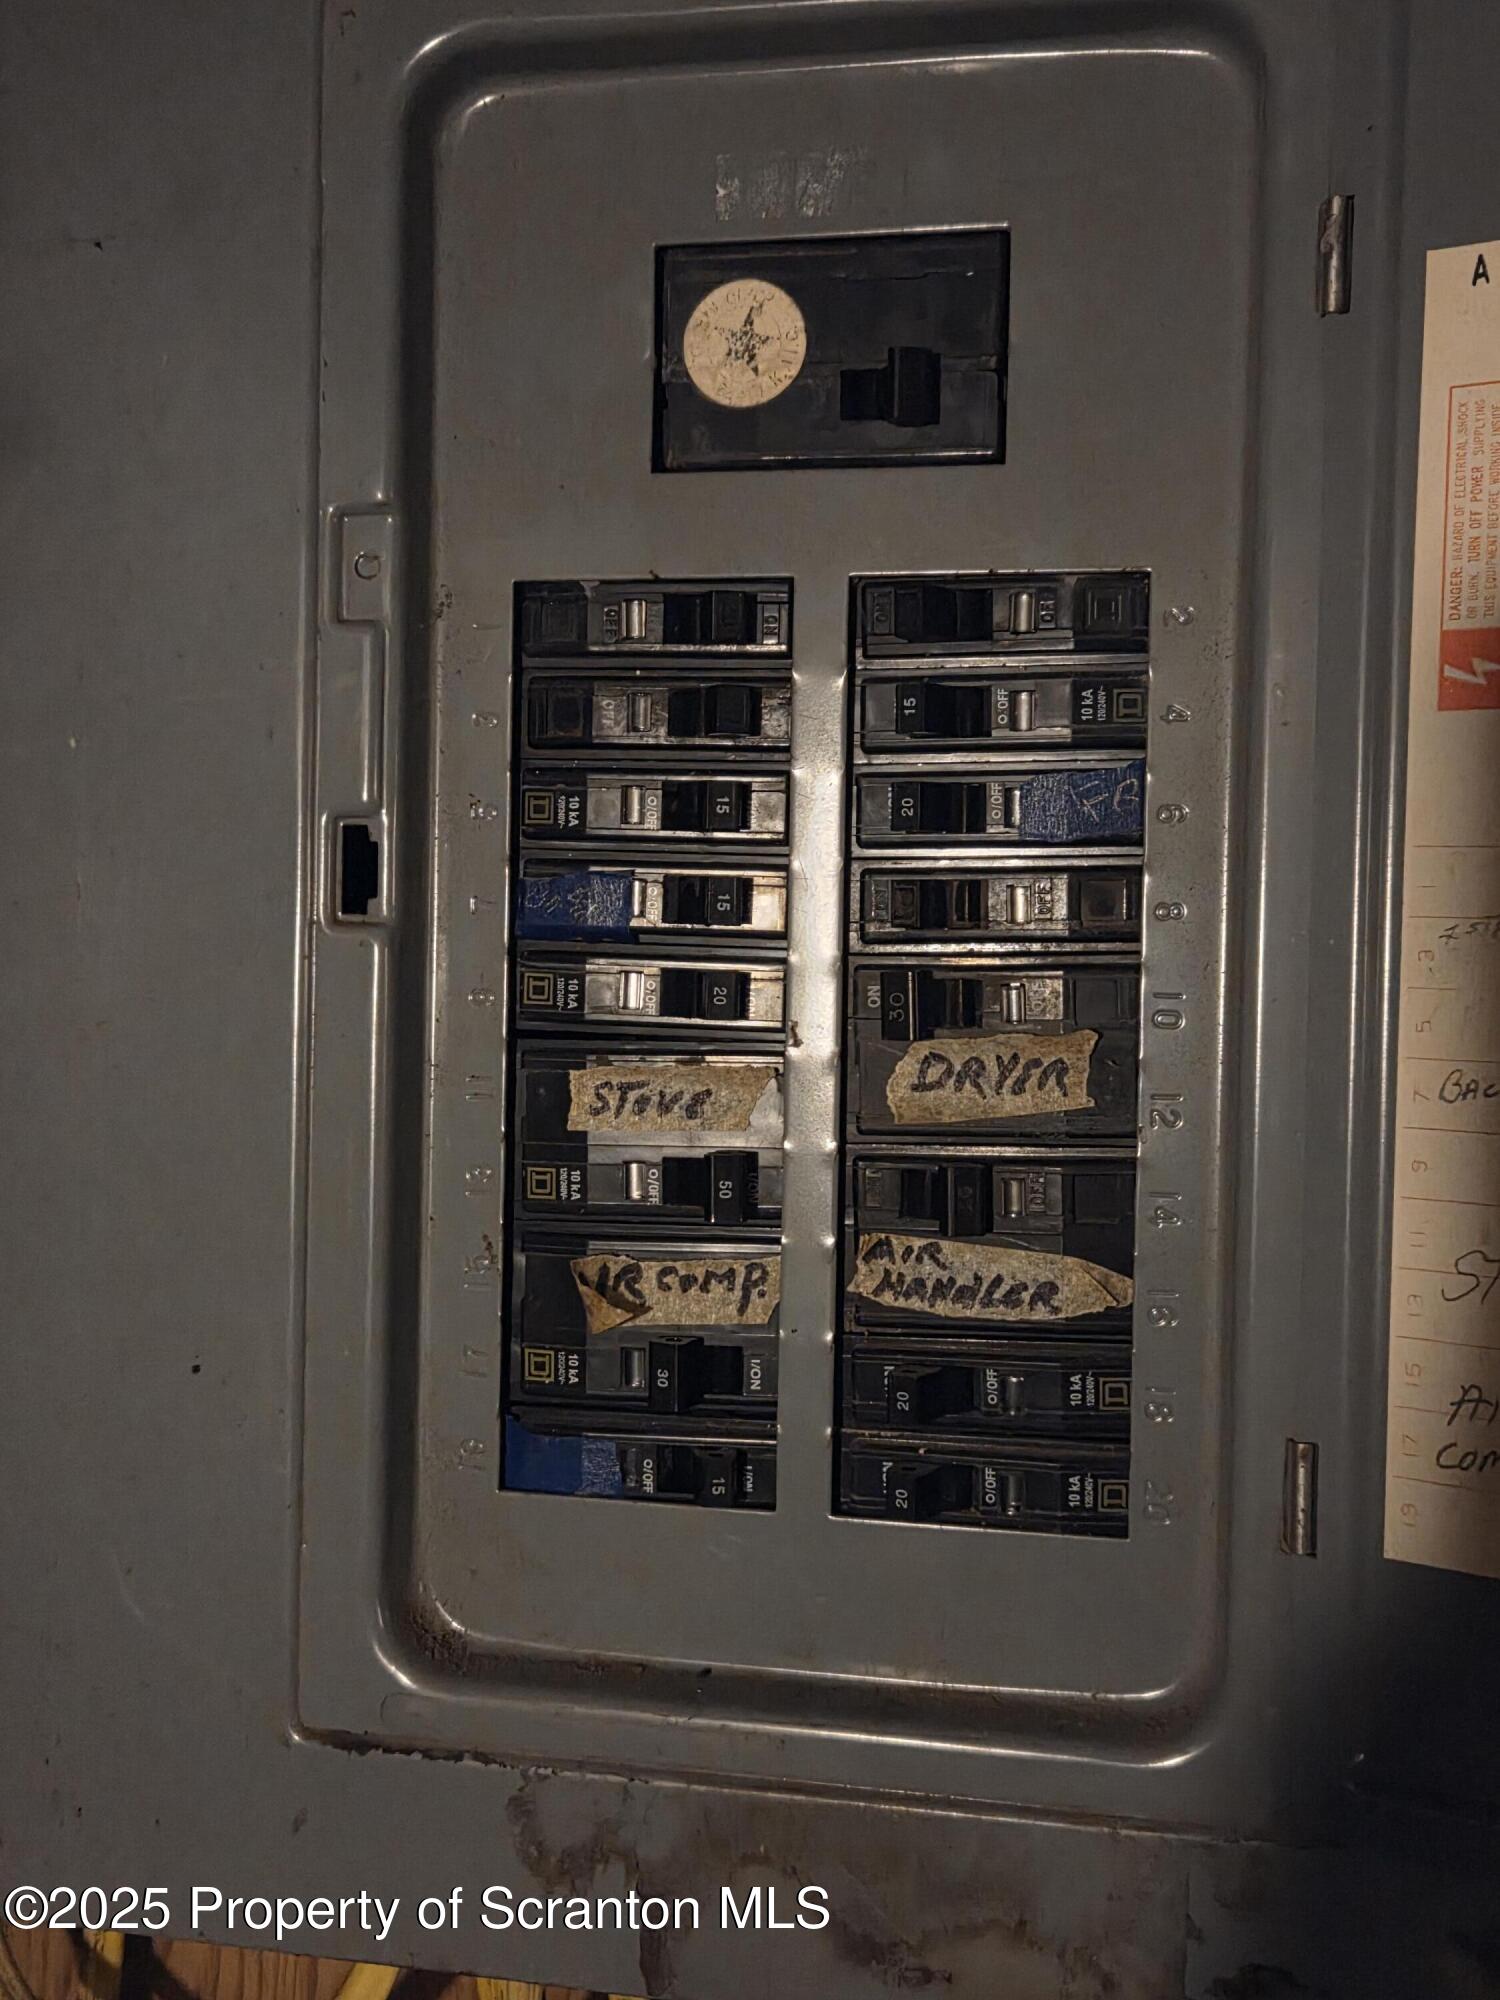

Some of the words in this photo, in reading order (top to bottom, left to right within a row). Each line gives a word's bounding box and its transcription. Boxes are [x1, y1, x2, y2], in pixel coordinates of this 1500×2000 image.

[1457, 400, 1468, 436] SHOCK
[1472, 399, 1486, 456] SUPPLYING
[1454, 440, 1468, 499] ELECTRICAL
[1489, 441, 1500, 485] WORKING
[1470, 466, 1484, 503] POWER
[1454, 505, 1464, 516] OF
[1487, 488, 1499, 529] BEFORE
[1469, 510, 1482, 529] OFF
[1452, 522, 1464, 561] HAZARD
[1468, 535, 1480, 563] TURN
[1485, 534, 1498, 589] EQUIPMENT
[1448, 567, 1462, 621] DANGER:
[1466, 606, 1477, 619] OR
[1484, 594, 1496, 618] THIS
[764, 615, 778, 635] ON
[904, 697, 917, 716] 15
[1081, 688, 1093, 706] kA
[1081, 707, 1093, 721] 10
[568, 797, 580, 810] 10
[716, 797, 730, 814] 15
[901, 797, 914, 817] 20
[991, 783, 1004, 819] O/OFF
[568, 811, 580, 827] kA
[717, 894, 730, 912] 15
[1155, 902, 1187, 922] 8
[568, 979, 579, 993] 10
[713, 986, 727, 1005] 20
[568, 994, 579, 1009] kA
[867, 986, 881, 1008] ON
[889, 993, 905, 1022] 30
[1153, 992, 1186, 1030] 10
[1416, 1021, 1432, 1033] 5
[1151, 1093, 1184, 1130] 12
[571, 1170, 580, 1183] 10
[570, 1184, 580, 1200] kA
[648, 1168, 659, 1206] O/OFF
[719, 1180, 732, 1199] 50
[578, 1262, 648, 1307] IR
[569, 1354, 579, 1367] 10
[568, 1368, 579, 1384] kA
[657, 1369, 668, 1388] 30
[750, 1359, 761, 1391] I/ON
[1071, 1374, 1082, 1390] kA
[1405, 1363, 1422, 1387] 15
[988, 1369, 998, 1405] O/OFF
[897, 1391, 909, 1412] 20
[1071, 1391, 1082, 1406] 10
[642, 1458, 654, 1494] O/OFF
[712, 1477, 725, 1495] 15
[986, 1467, 997, 1504] O/OFF
[1069, 1475, 1081, 1491] kA
[896, 1489, 908, 1510] 20
[1069, 1492, 1081, 1507] 10
